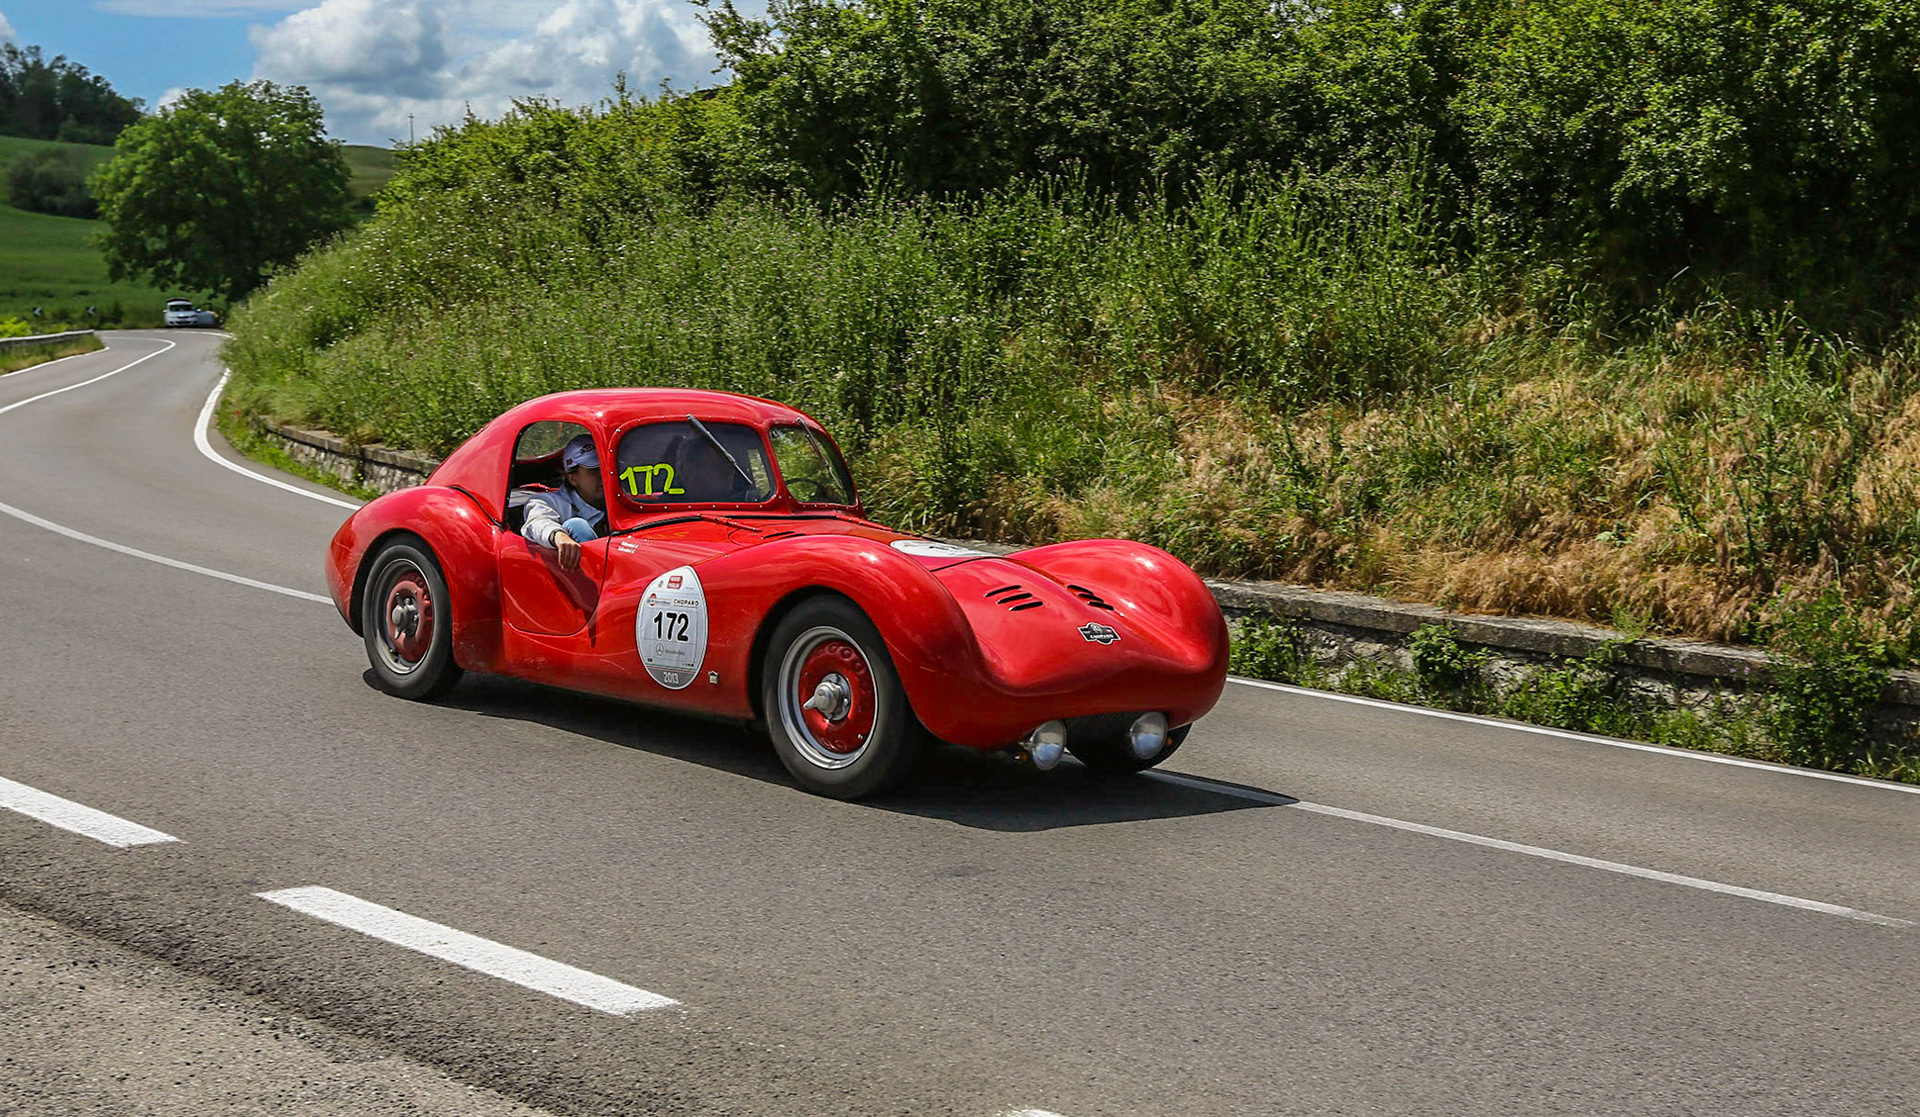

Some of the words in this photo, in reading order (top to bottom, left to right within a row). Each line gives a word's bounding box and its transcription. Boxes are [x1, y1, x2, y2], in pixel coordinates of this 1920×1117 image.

[619, 463, 685, 496] 172
[673, 598, 700, 607] CHOPARD
[653, 610, 690, 642] 172
[663, 671, 680, 685] 2013
